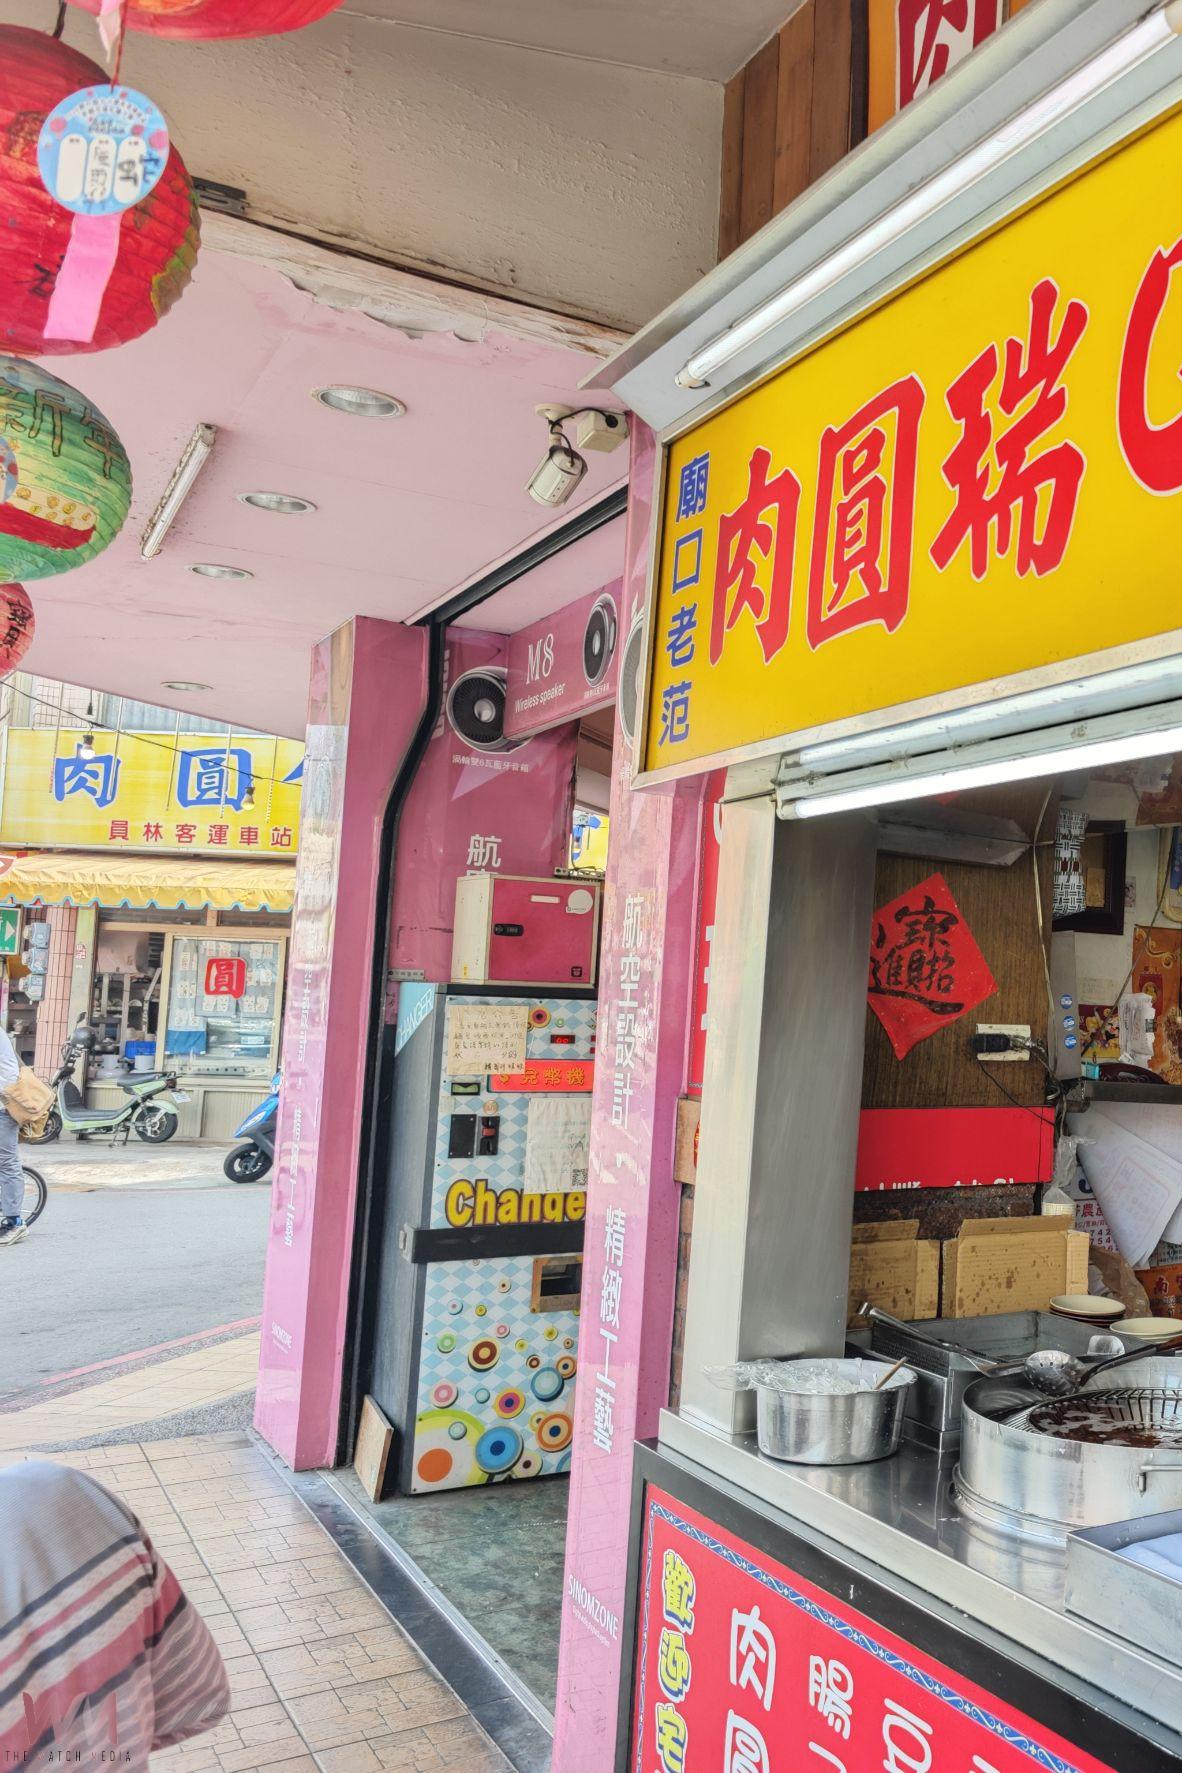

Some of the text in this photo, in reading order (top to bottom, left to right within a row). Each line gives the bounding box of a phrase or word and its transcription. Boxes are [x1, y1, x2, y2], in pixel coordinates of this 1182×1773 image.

[658, 451, 710, 747] 廟口老范
[526, 633, 555, 686] M8
[515, 693, 540, 713] Wireless
[540, 682, 567, 706] speaker
[54, 742, 304, 812] 肉圓
[108, 820, 293, 847] 員林客運車站
[466, 833, 503, 877] 航
[568, 1574, 619, 1641] SINOMZONE
